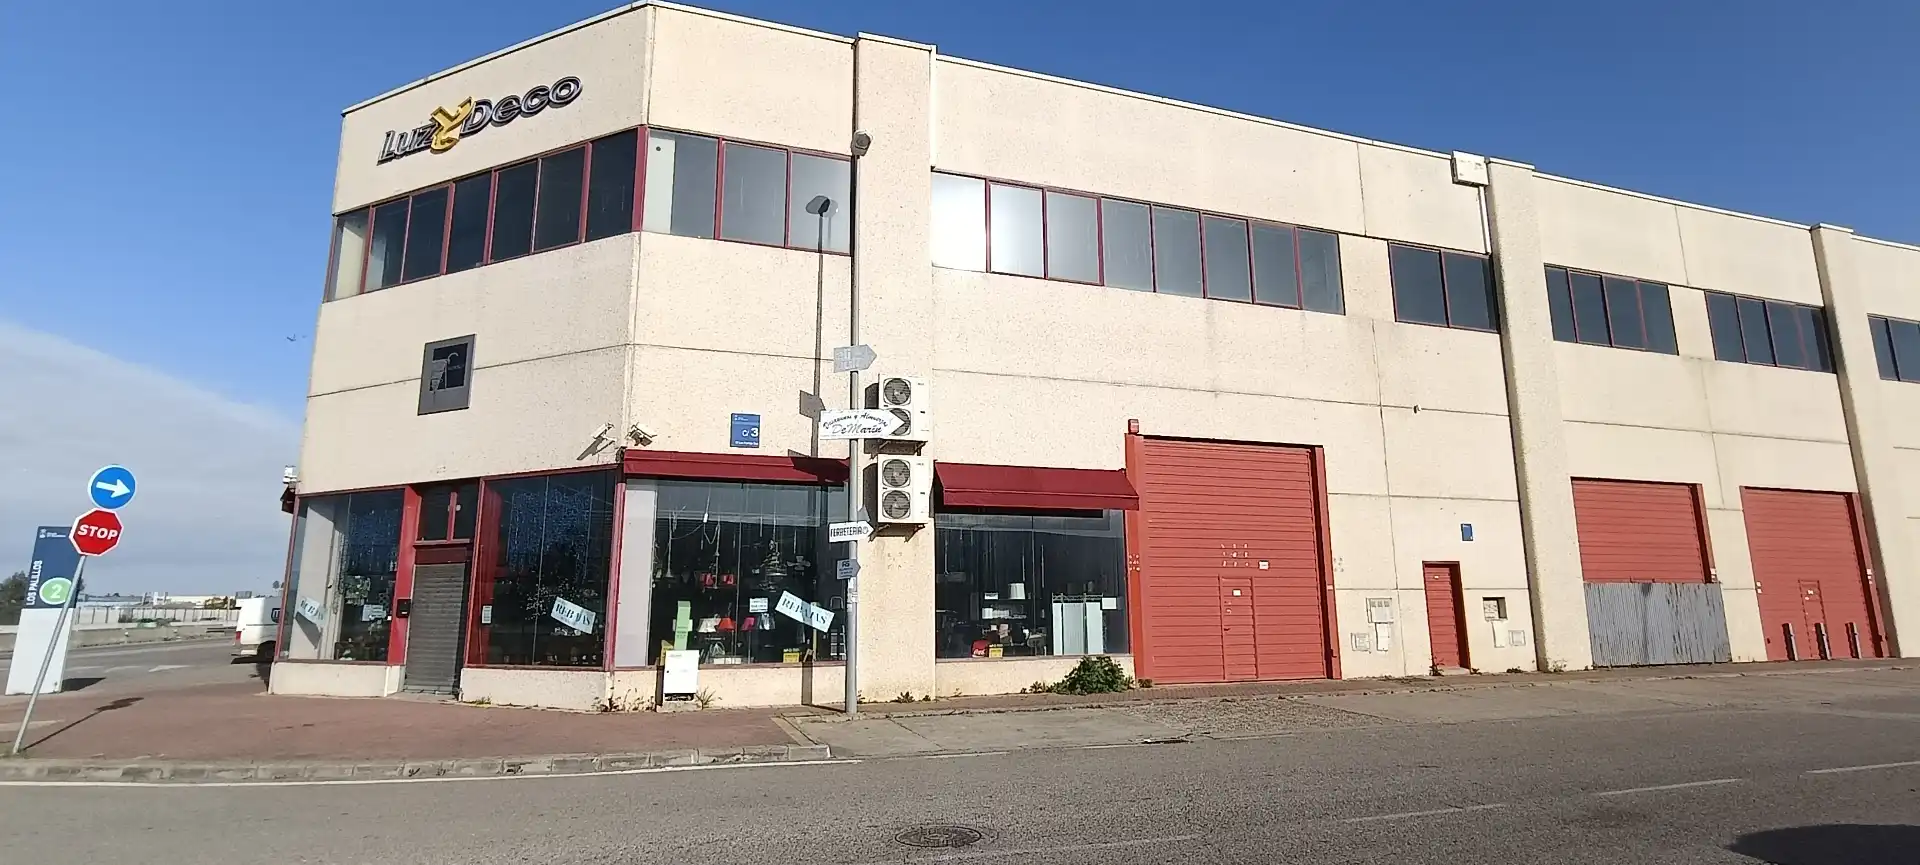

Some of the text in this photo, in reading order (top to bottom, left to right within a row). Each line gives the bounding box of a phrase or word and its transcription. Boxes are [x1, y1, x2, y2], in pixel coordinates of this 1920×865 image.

[77, 524, 119, 540] STOP
[26, 560, 43, 605] LOS PALILLOS
[50, 583, 63, 599] 2
